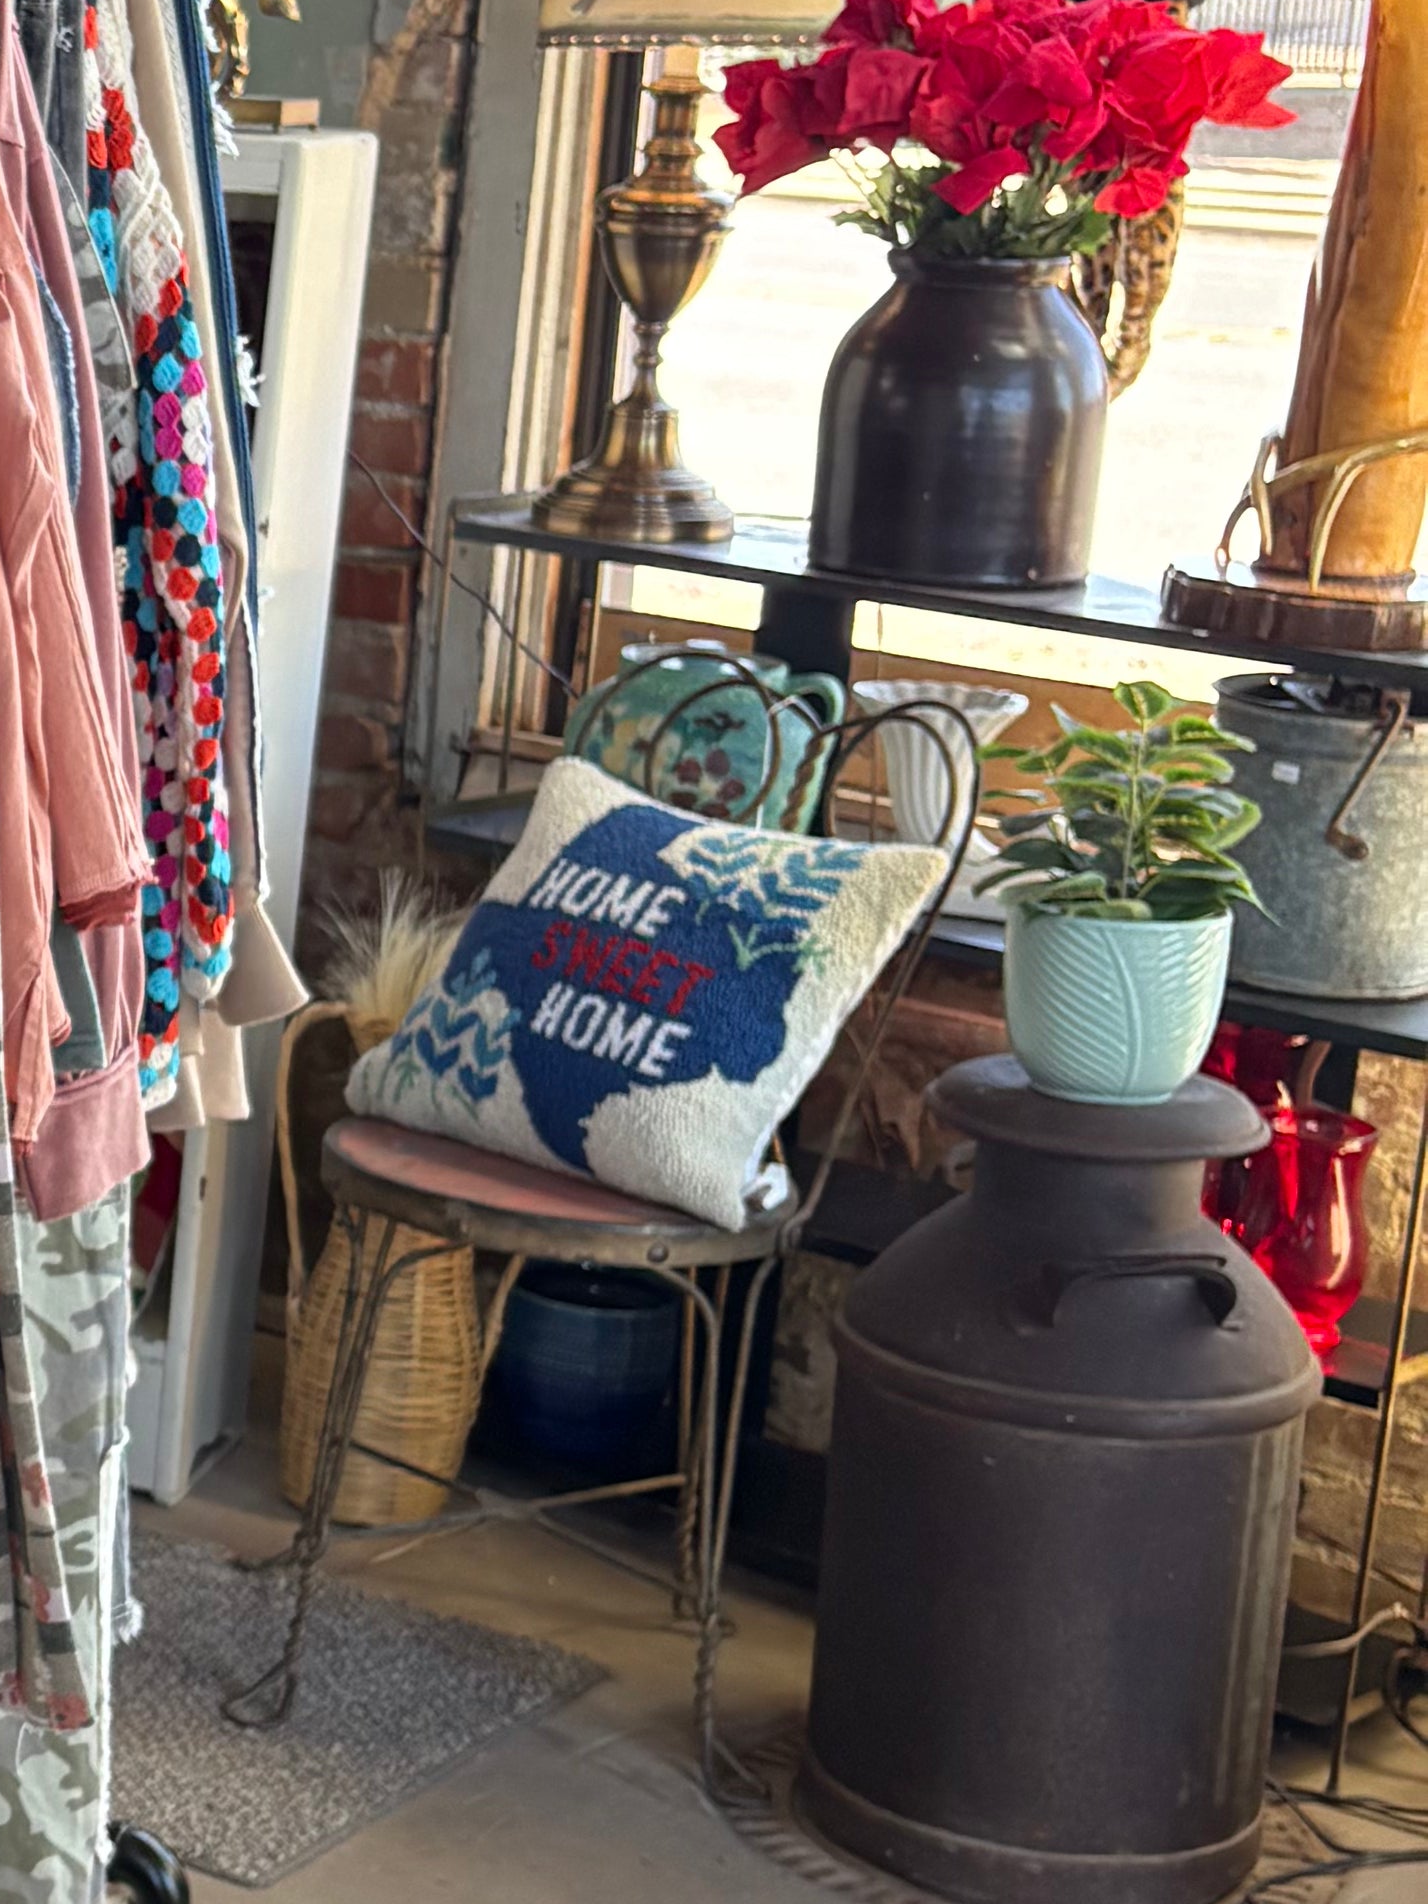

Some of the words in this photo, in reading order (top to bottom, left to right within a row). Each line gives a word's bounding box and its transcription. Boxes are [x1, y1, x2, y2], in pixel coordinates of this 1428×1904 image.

[530, 859, 688, 938] HOME
[532, 922, 714, 1016] SWEET
[530, 982, 692, 1078] HOME
